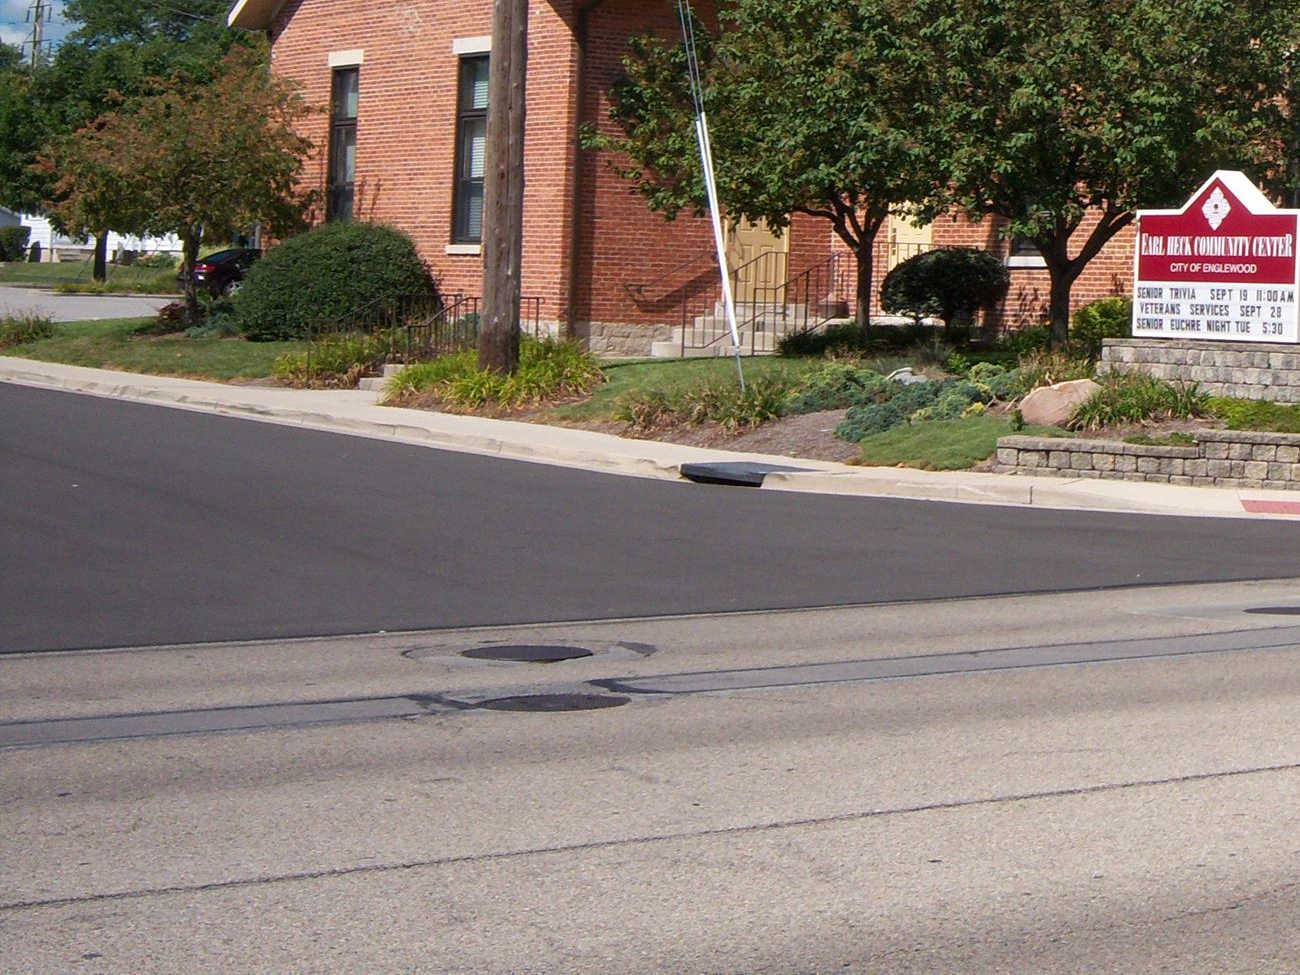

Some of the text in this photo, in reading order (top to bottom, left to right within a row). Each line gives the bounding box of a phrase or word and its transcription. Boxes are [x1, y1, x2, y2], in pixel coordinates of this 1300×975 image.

[1141, 233, 1293, 257] EARL HECK COMMUNITY CENTER
[1170, 263, 1257, 274] CITY OF ENGLEWOOD
[1137, 287, 1163, 299] SENIOR
[1169, 288, 1196, 300] TRIVIA
[1210, 289, 1234, 301] SEPT
[1140, 302, 1181, 315] VETERANS
[1189, 304, 1230, 317] SERVICES
[1240, 305, 1262, 318] SEPT
[1136, 318, 1283, 335] SENIOR EUCHRE NIGHT TUE 5:30
